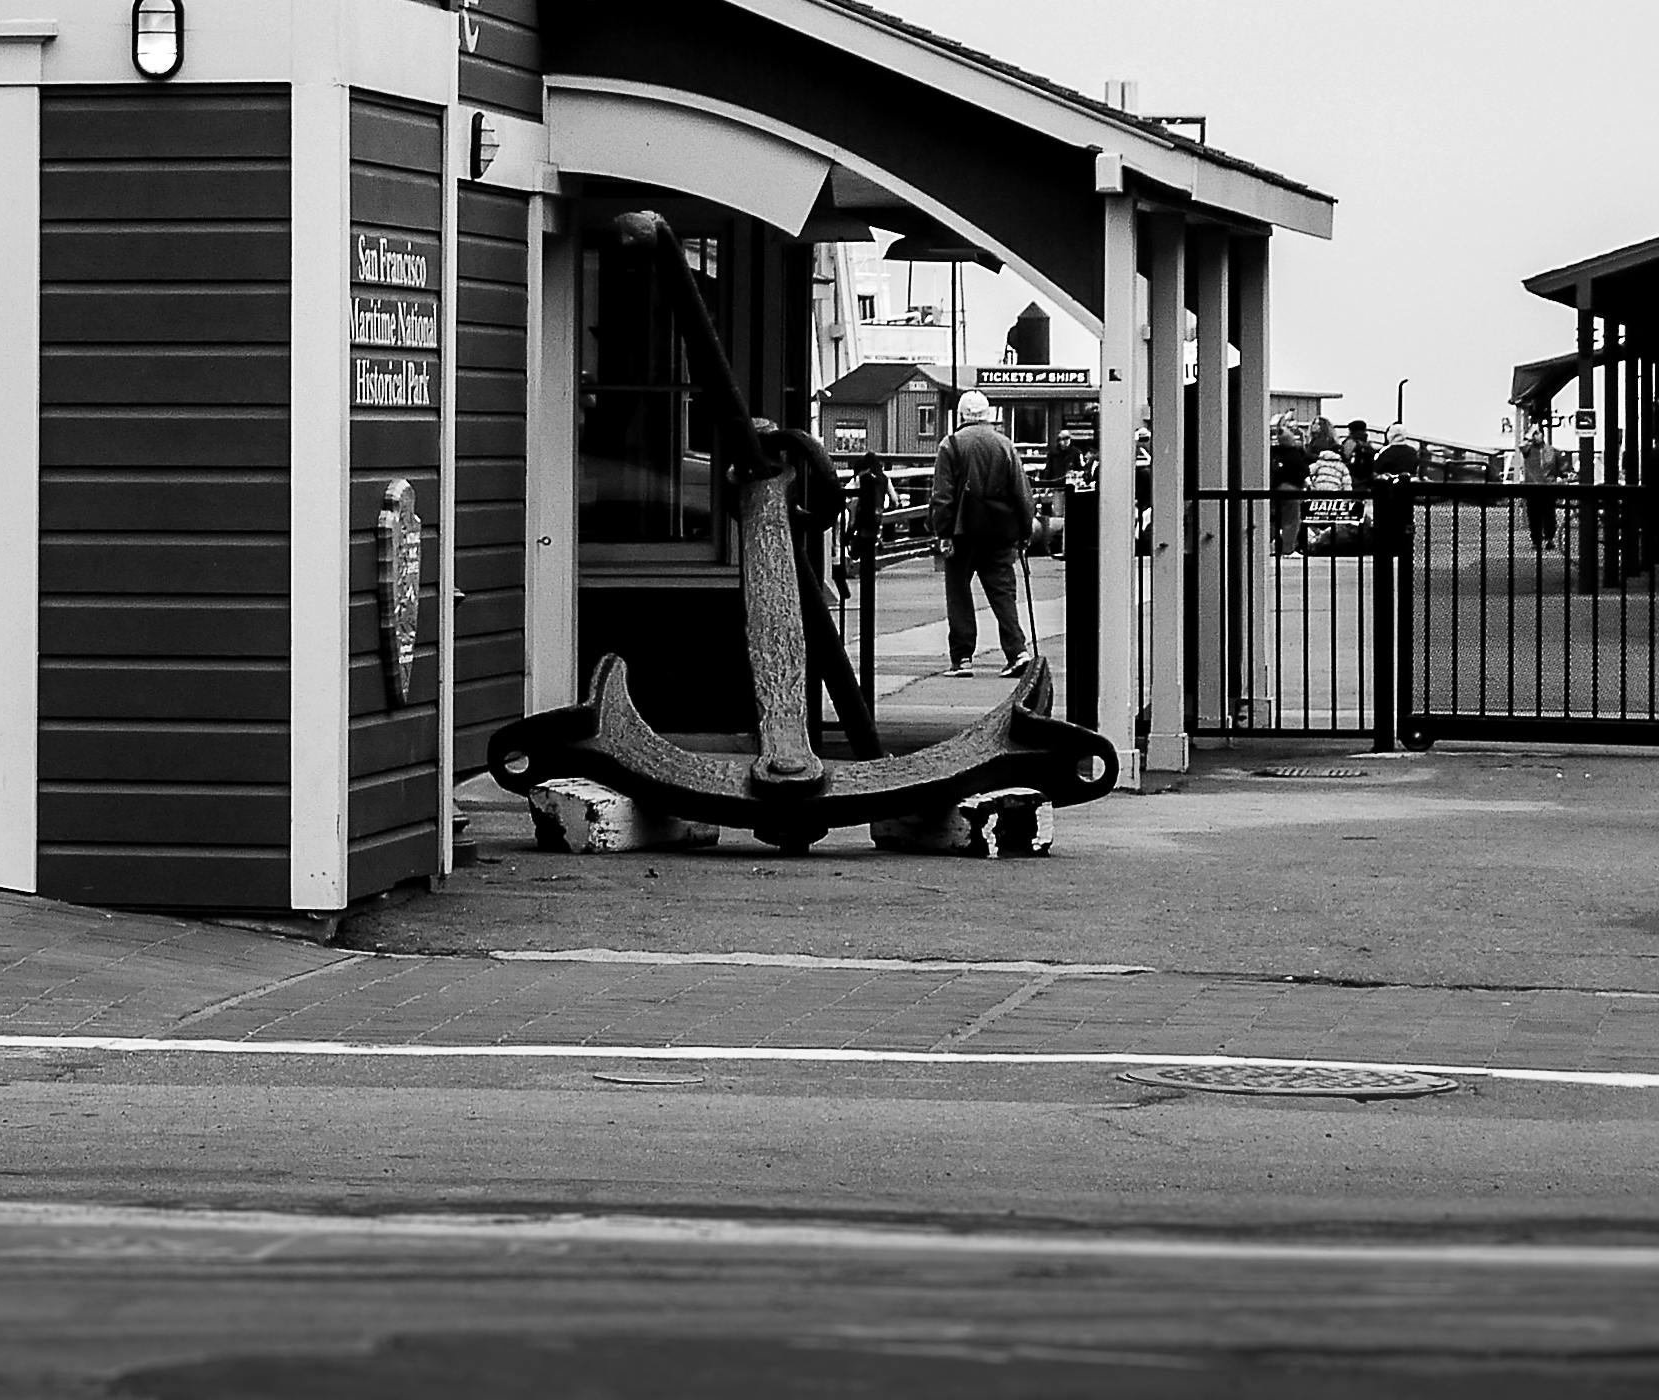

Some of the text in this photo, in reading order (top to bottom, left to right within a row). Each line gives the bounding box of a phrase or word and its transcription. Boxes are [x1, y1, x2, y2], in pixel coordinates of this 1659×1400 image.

[357, 234, 428, 289] San Francisco
[350, 297, 438, 349] Maritime National
[355, 358, 431, 406] Historical Park
[981, 371, 1034, 383] TICKETS
[1048, 372, 1086, 383] SHIPS
[1309, 500, 1356, 512] BAILEY
